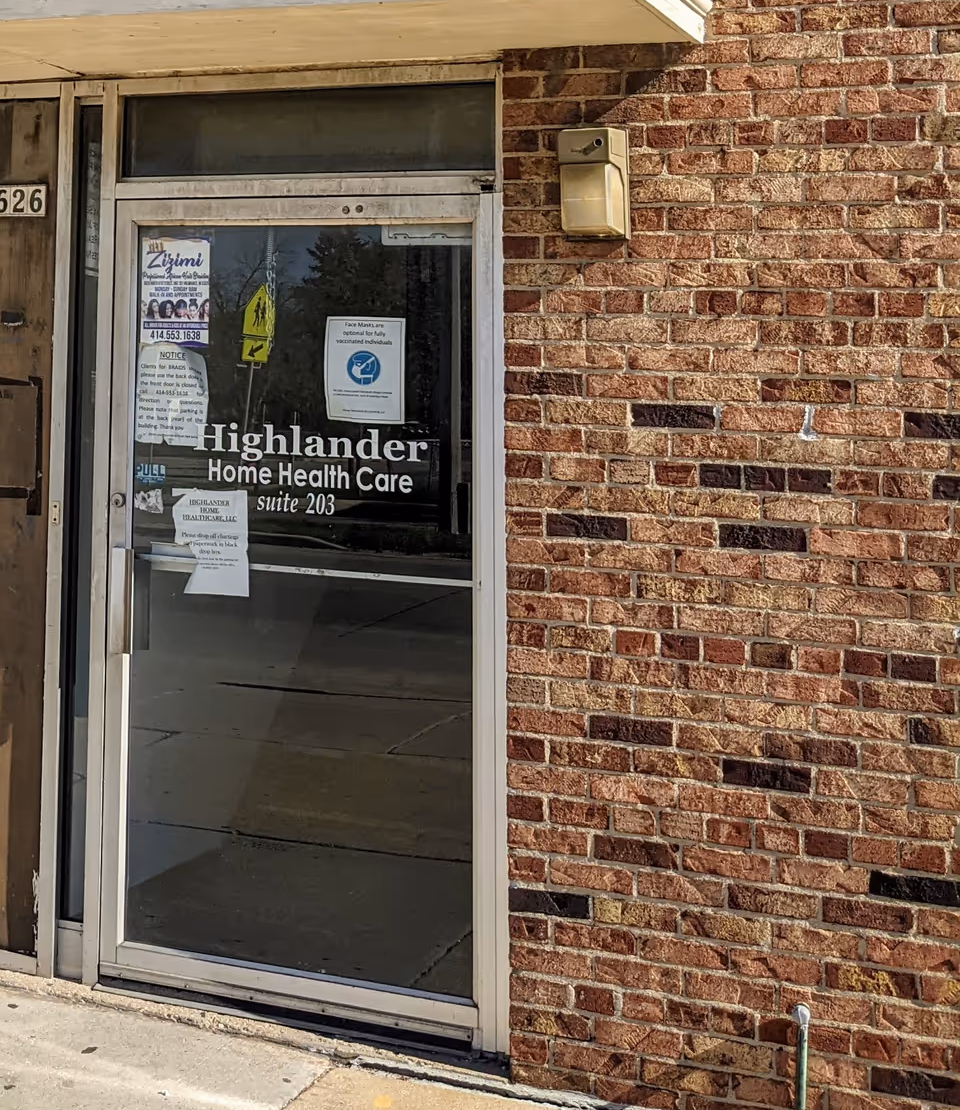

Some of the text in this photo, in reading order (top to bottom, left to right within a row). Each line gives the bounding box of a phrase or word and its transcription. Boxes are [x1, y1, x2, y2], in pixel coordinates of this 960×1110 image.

[146, 250, 204, 274] Zizimi
[150, 330, 201, 341] 414.553.1638
[160, 351, 186, 359] NOTICE
[193, 422, 429, 463] Highlander
[135, 463, 166, 477] PULL
[208, 458, 414, 494] Home Health Care
[256, 490, 336, 516] suite 203
